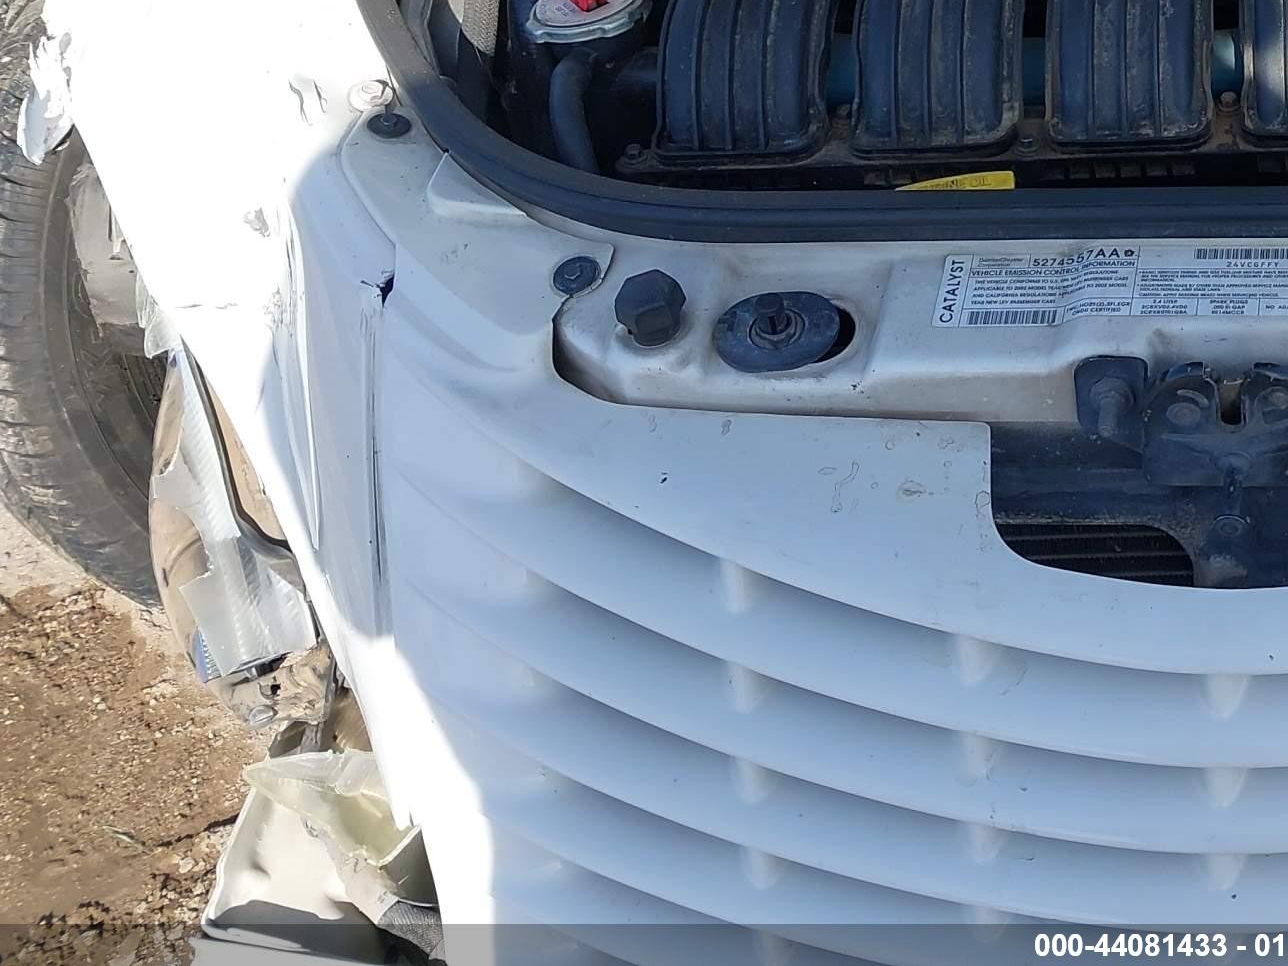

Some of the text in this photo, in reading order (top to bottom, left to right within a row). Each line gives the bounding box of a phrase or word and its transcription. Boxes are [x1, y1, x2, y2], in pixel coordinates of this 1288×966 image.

[971, 269, 1003, 277] VEHICLE
[1044, 267, 1080, 276] CONTROL
[1081, 260, 1136, 272] INFORMATION
[939, 259, 965, 324] CATALYST
